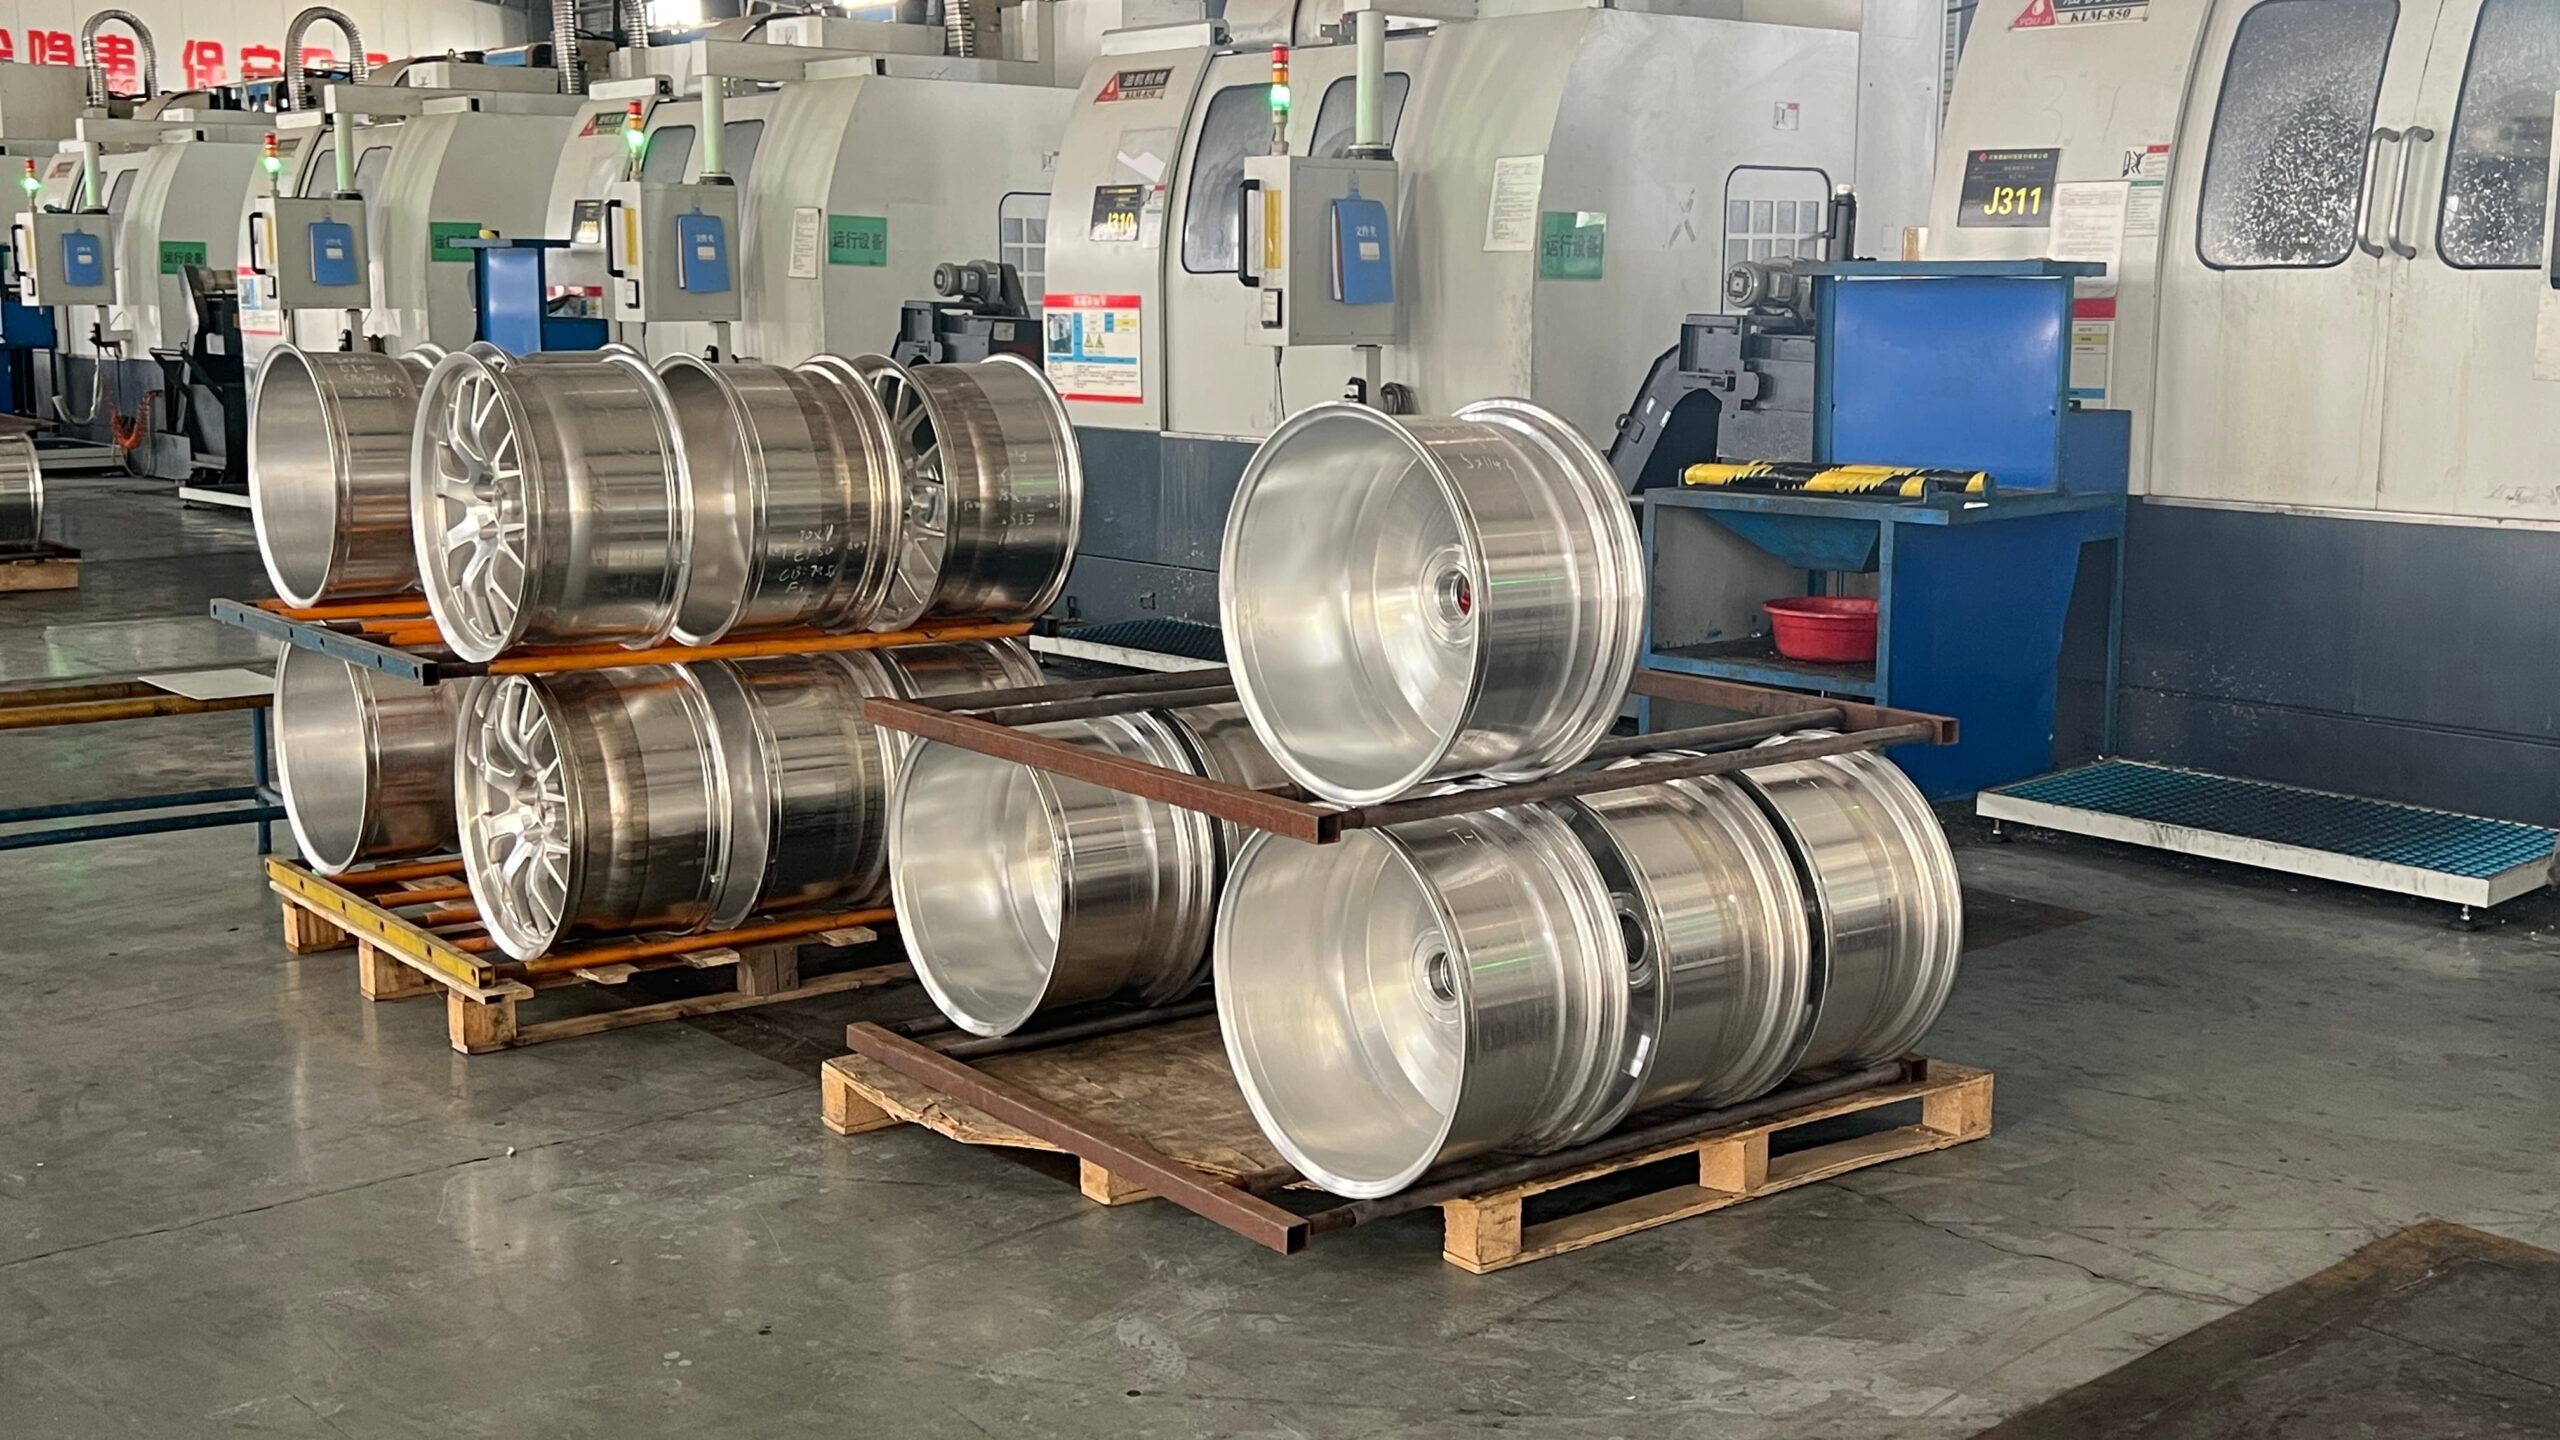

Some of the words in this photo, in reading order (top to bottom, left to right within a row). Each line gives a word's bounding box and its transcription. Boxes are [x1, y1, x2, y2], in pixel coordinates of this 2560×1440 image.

[2070, 8, 2132, 23] KLM-850
[0, 28, 137, 98] 隐患
[1983, 186, 2042, 216] J311
[832, 230, 884, 251] 运行设备
[1543, 232, 1602, 259] 运行设备
